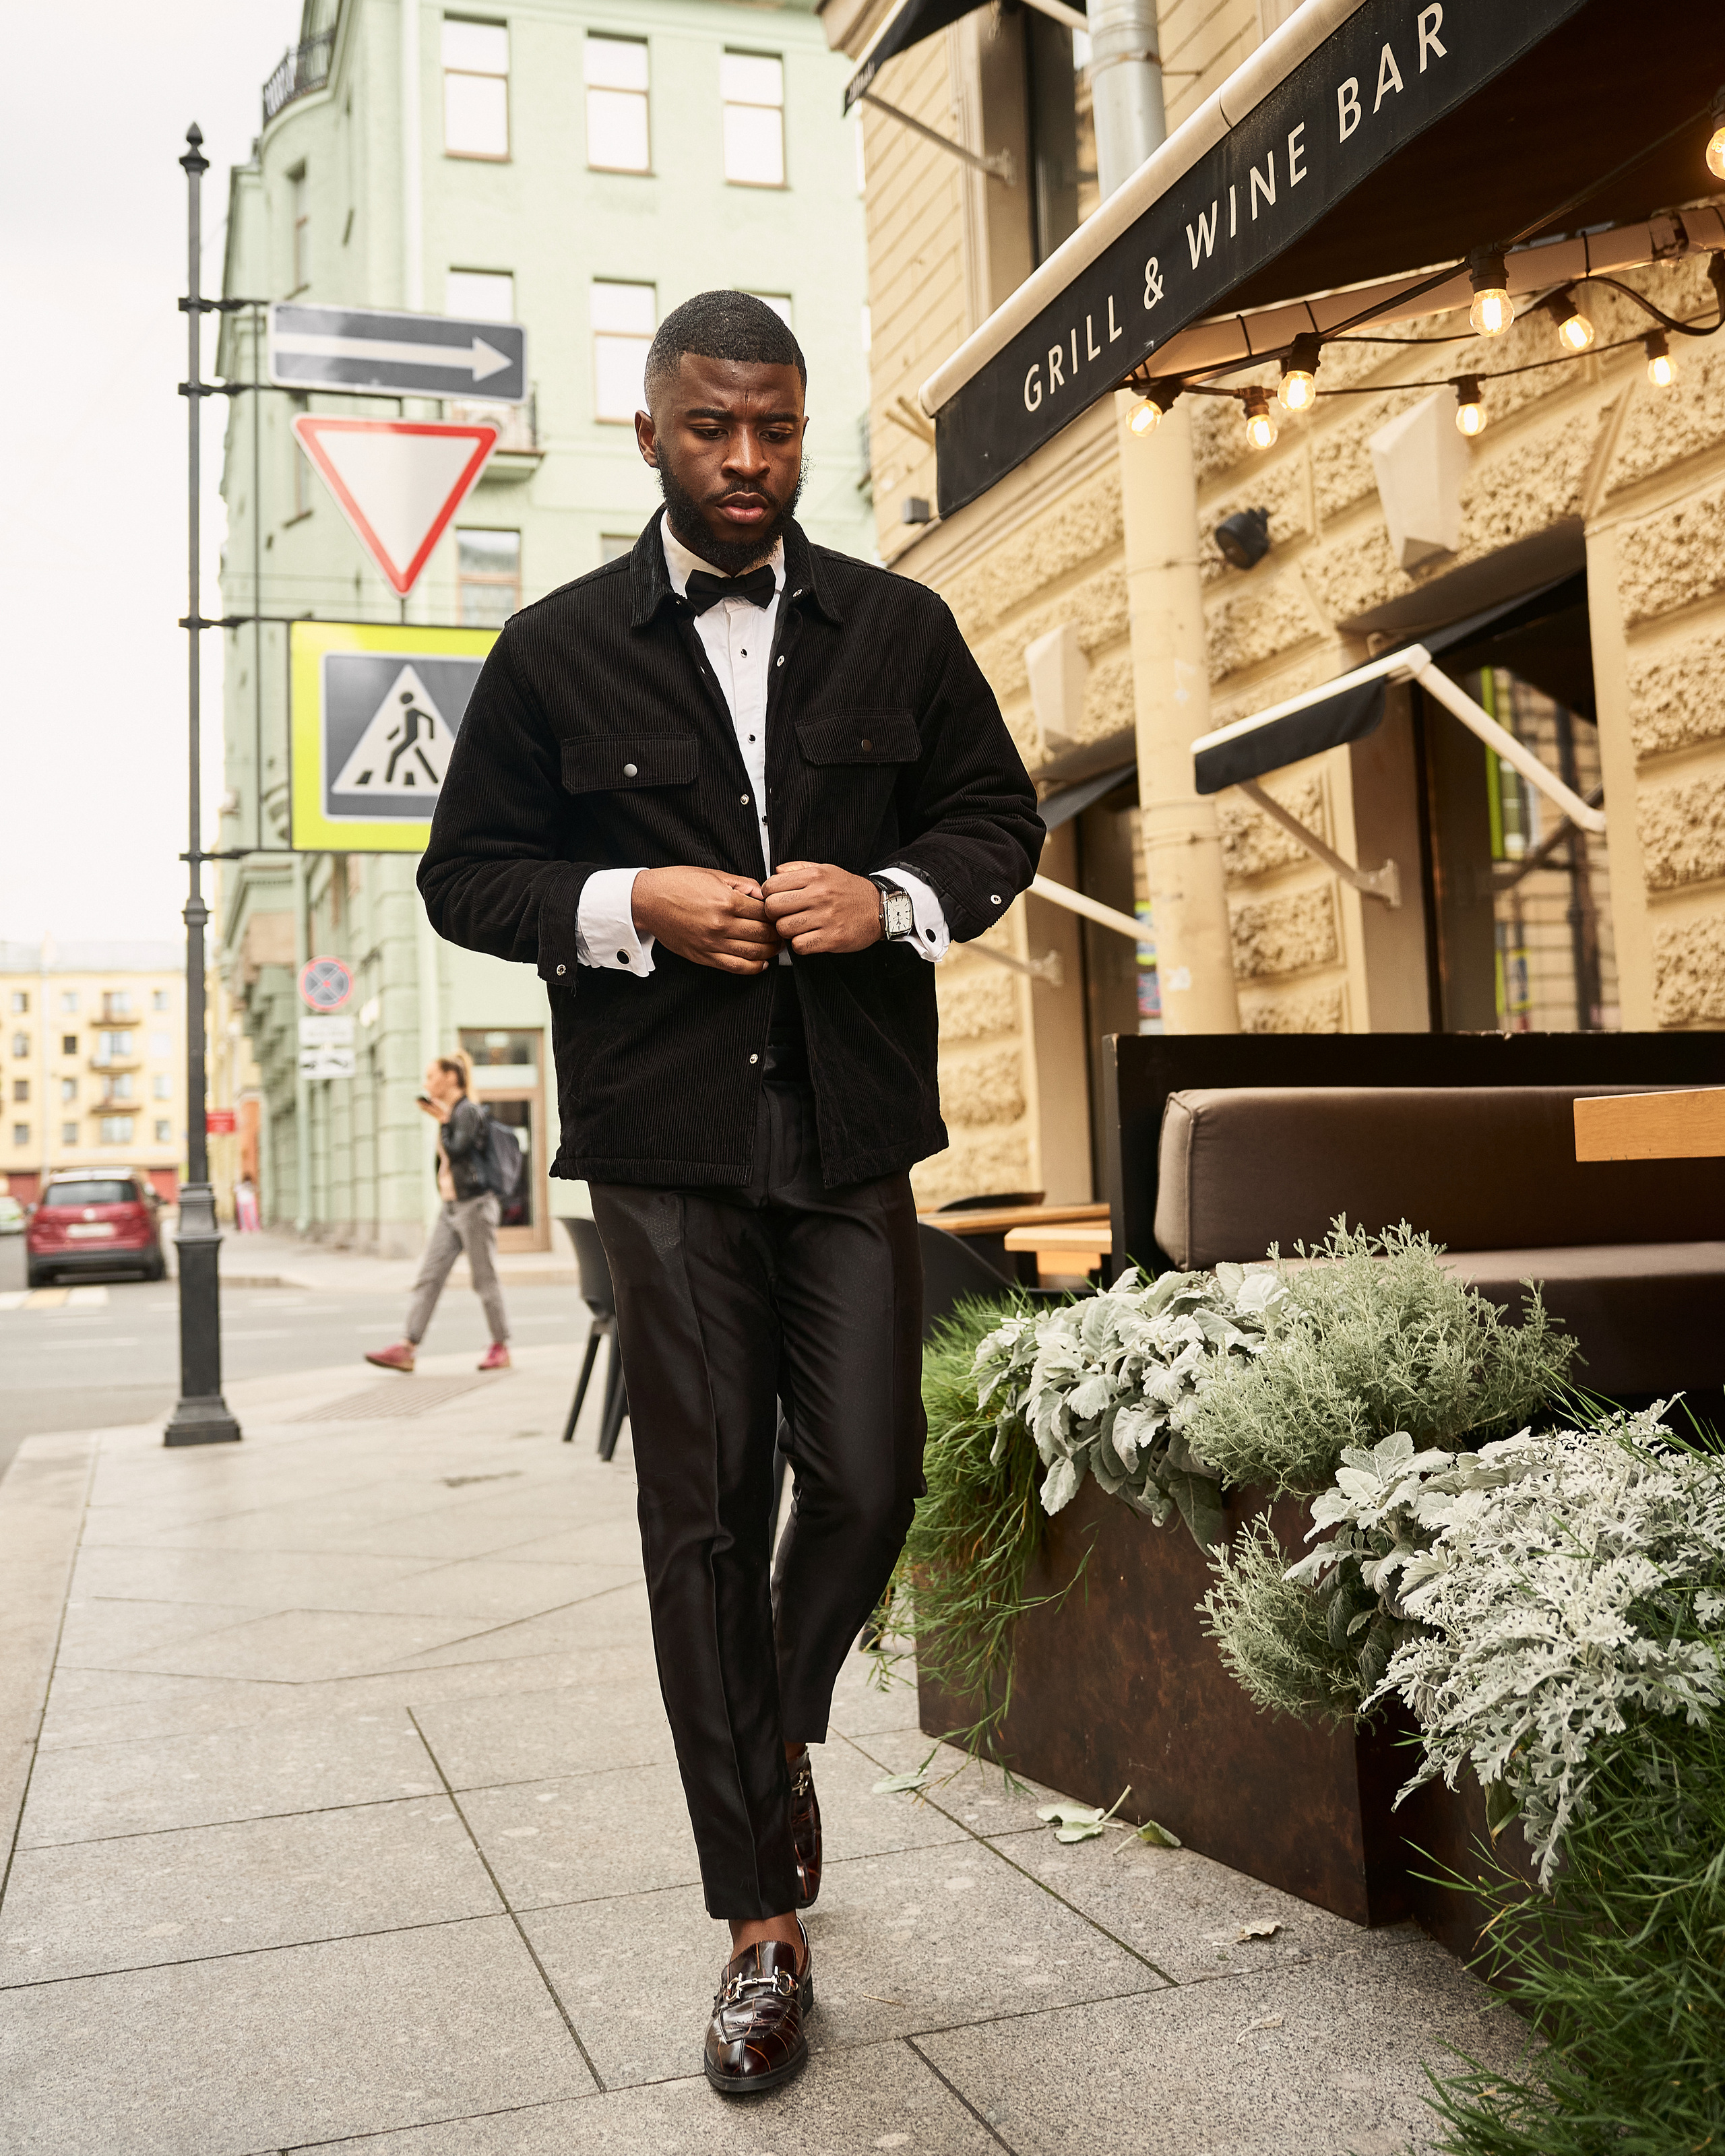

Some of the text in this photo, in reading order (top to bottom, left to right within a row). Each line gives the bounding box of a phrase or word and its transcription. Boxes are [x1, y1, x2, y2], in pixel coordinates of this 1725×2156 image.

[1024, 2, 1447, 412] GRILL & WINE BAR
